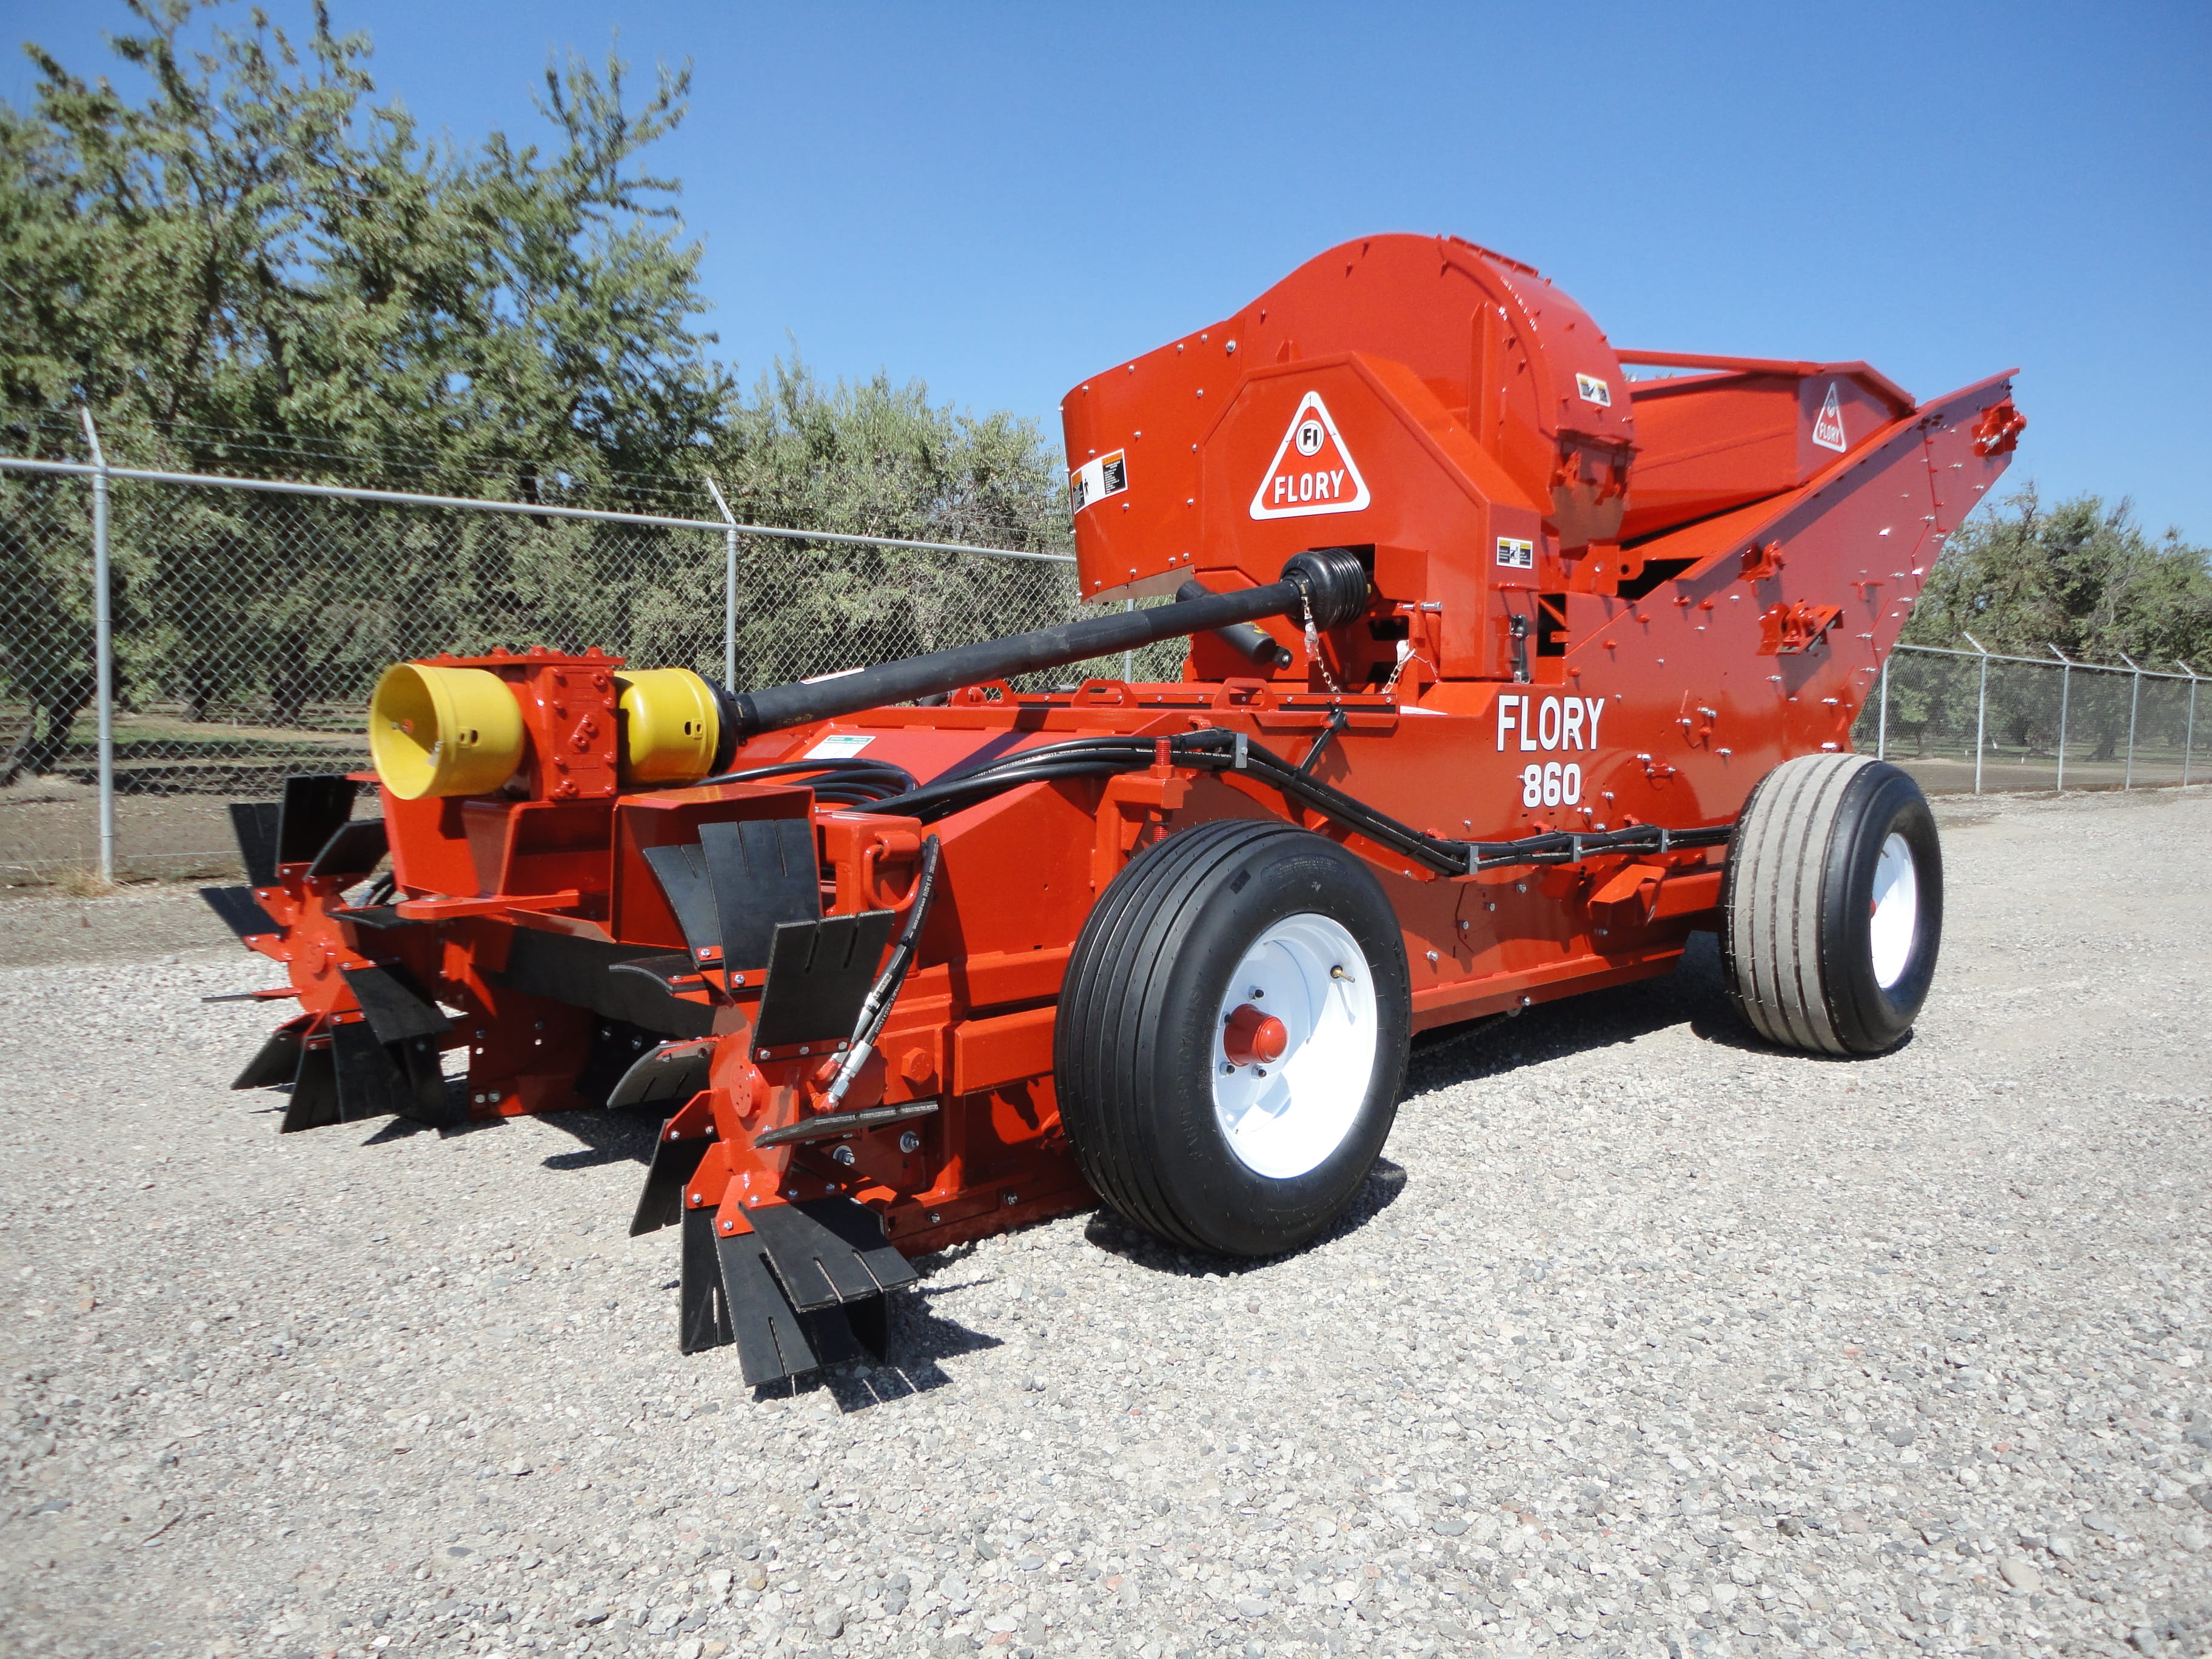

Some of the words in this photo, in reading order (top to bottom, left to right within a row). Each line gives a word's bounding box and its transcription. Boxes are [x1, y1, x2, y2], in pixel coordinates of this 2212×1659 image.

[1303, 428, 1318, 447] FI
[1818, 422, 1841, 444] FLORY
[1274, 469, 1345, 504] FLORY
[1497, 695, 1605, 751] FLORY
[1522, 762, 1581, 808] 860
